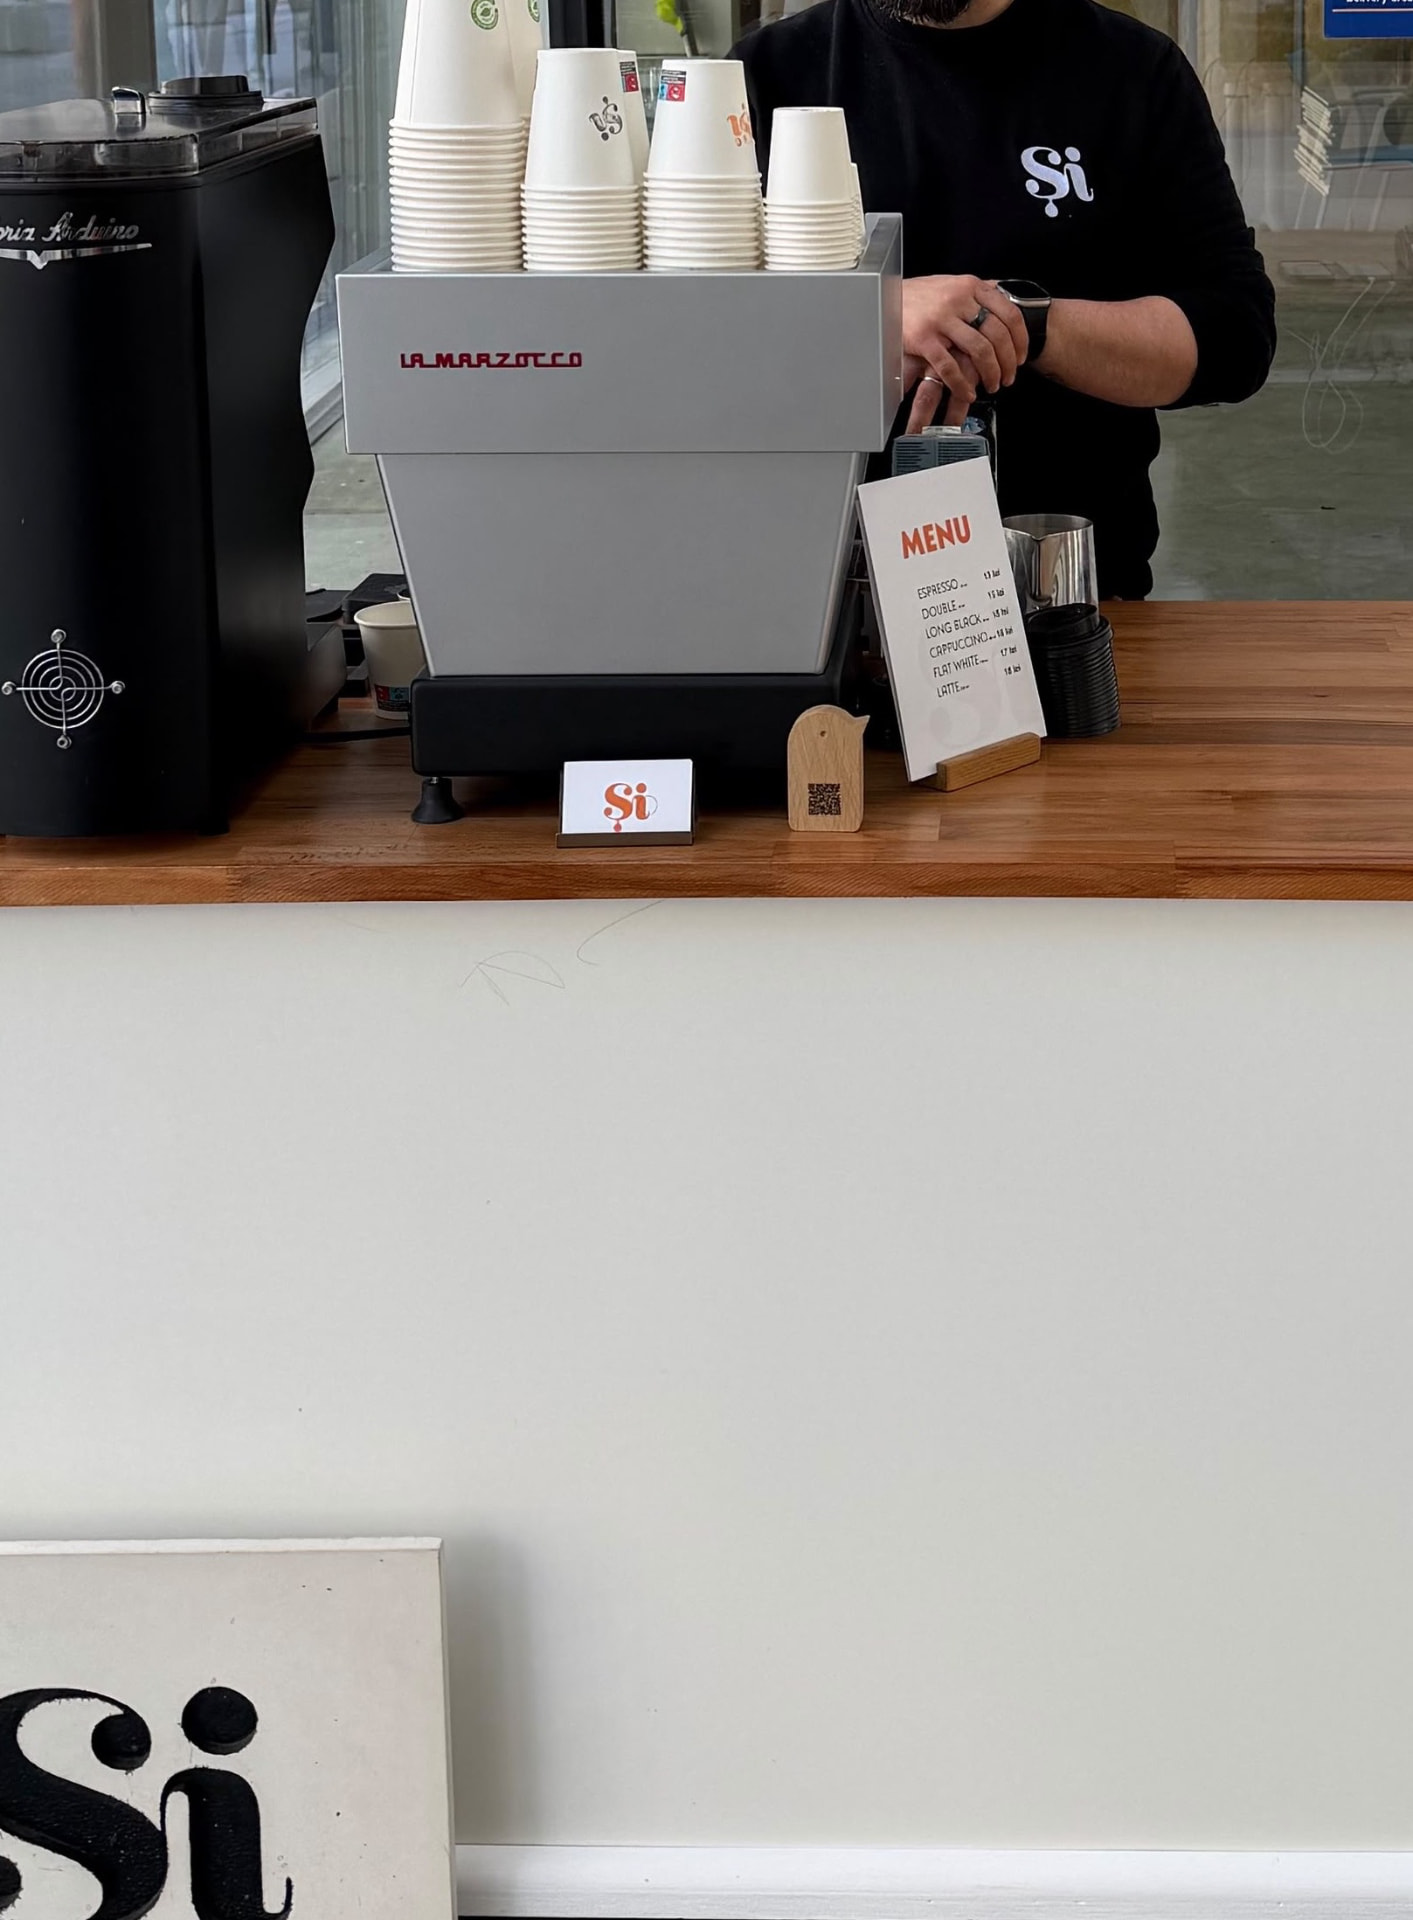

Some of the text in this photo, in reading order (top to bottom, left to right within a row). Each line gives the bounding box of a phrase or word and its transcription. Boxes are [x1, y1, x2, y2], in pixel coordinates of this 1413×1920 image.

[42, 211, 139, 242] Arduino
[400, 352, 582, 368] LA MARZOCCO
[901, 514, 971, 560] MENU
[925, 621, 952, 640] LONG
[933, 662, 952, 678] FLAT
